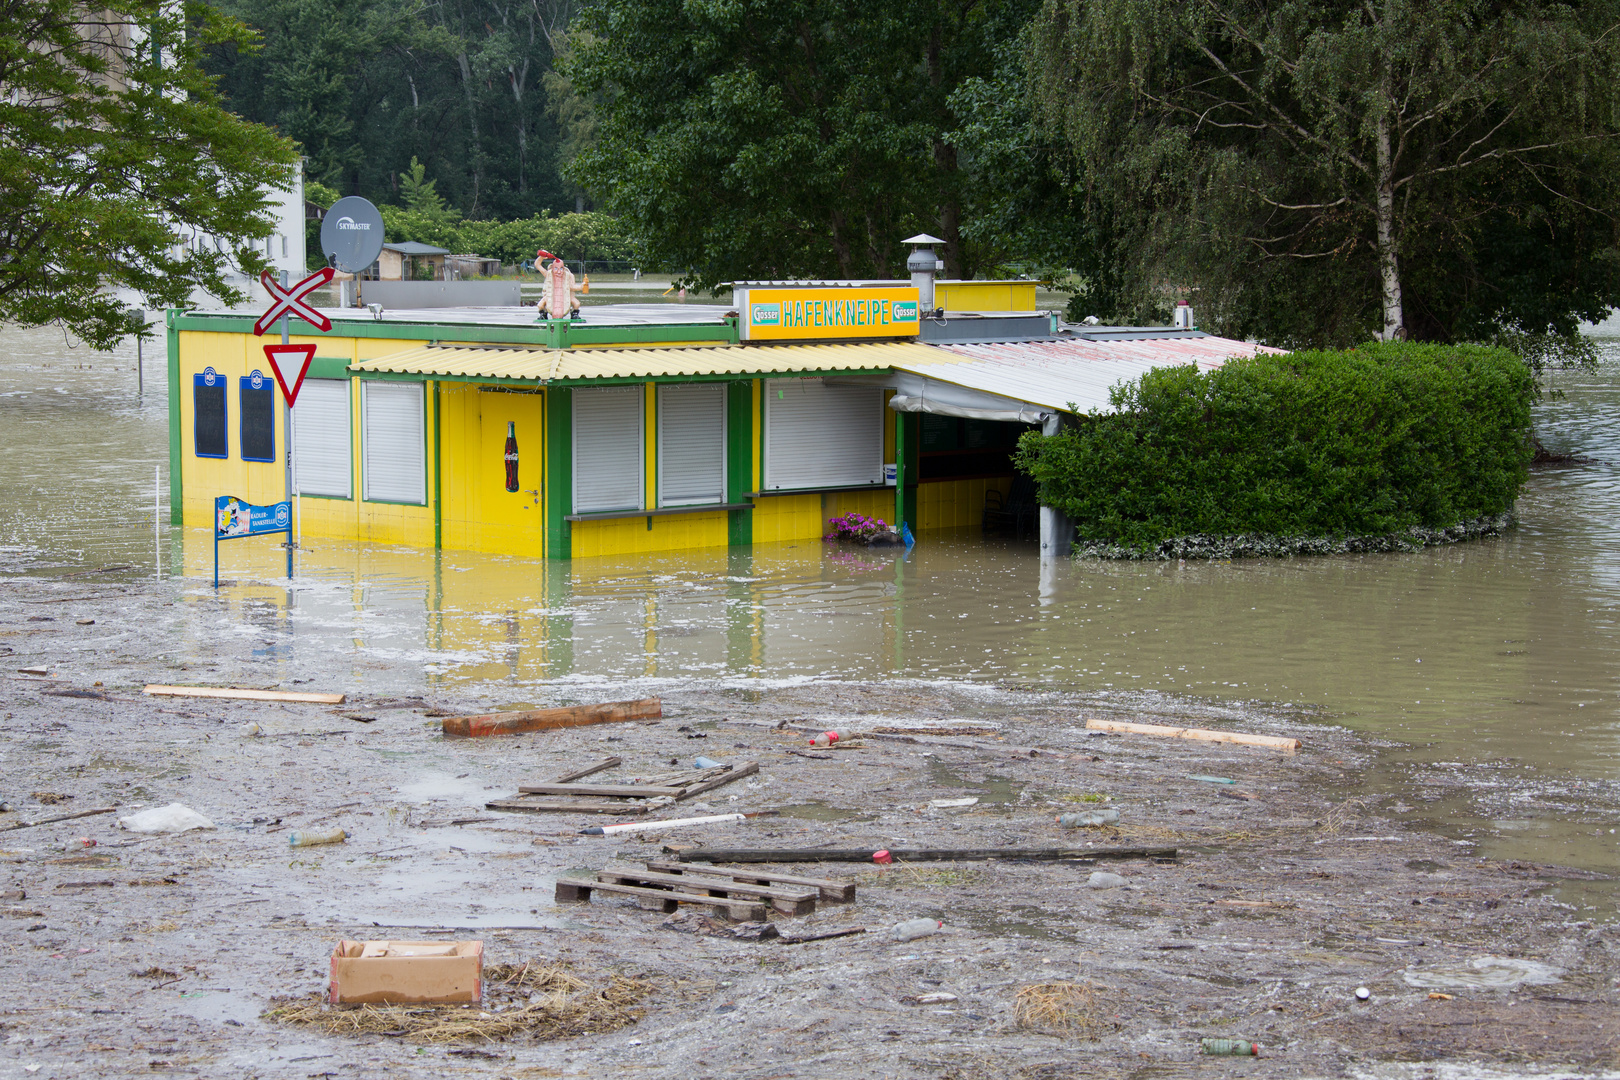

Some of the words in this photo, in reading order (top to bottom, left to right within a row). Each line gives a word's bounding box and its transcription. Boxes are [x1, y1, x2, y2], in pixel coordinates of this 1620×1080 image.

[754, 306, 778, 322] Gösser
[783, 299, 889, 327] HAFENKNEIPE
[894, 304, 916, 320] Gösser
